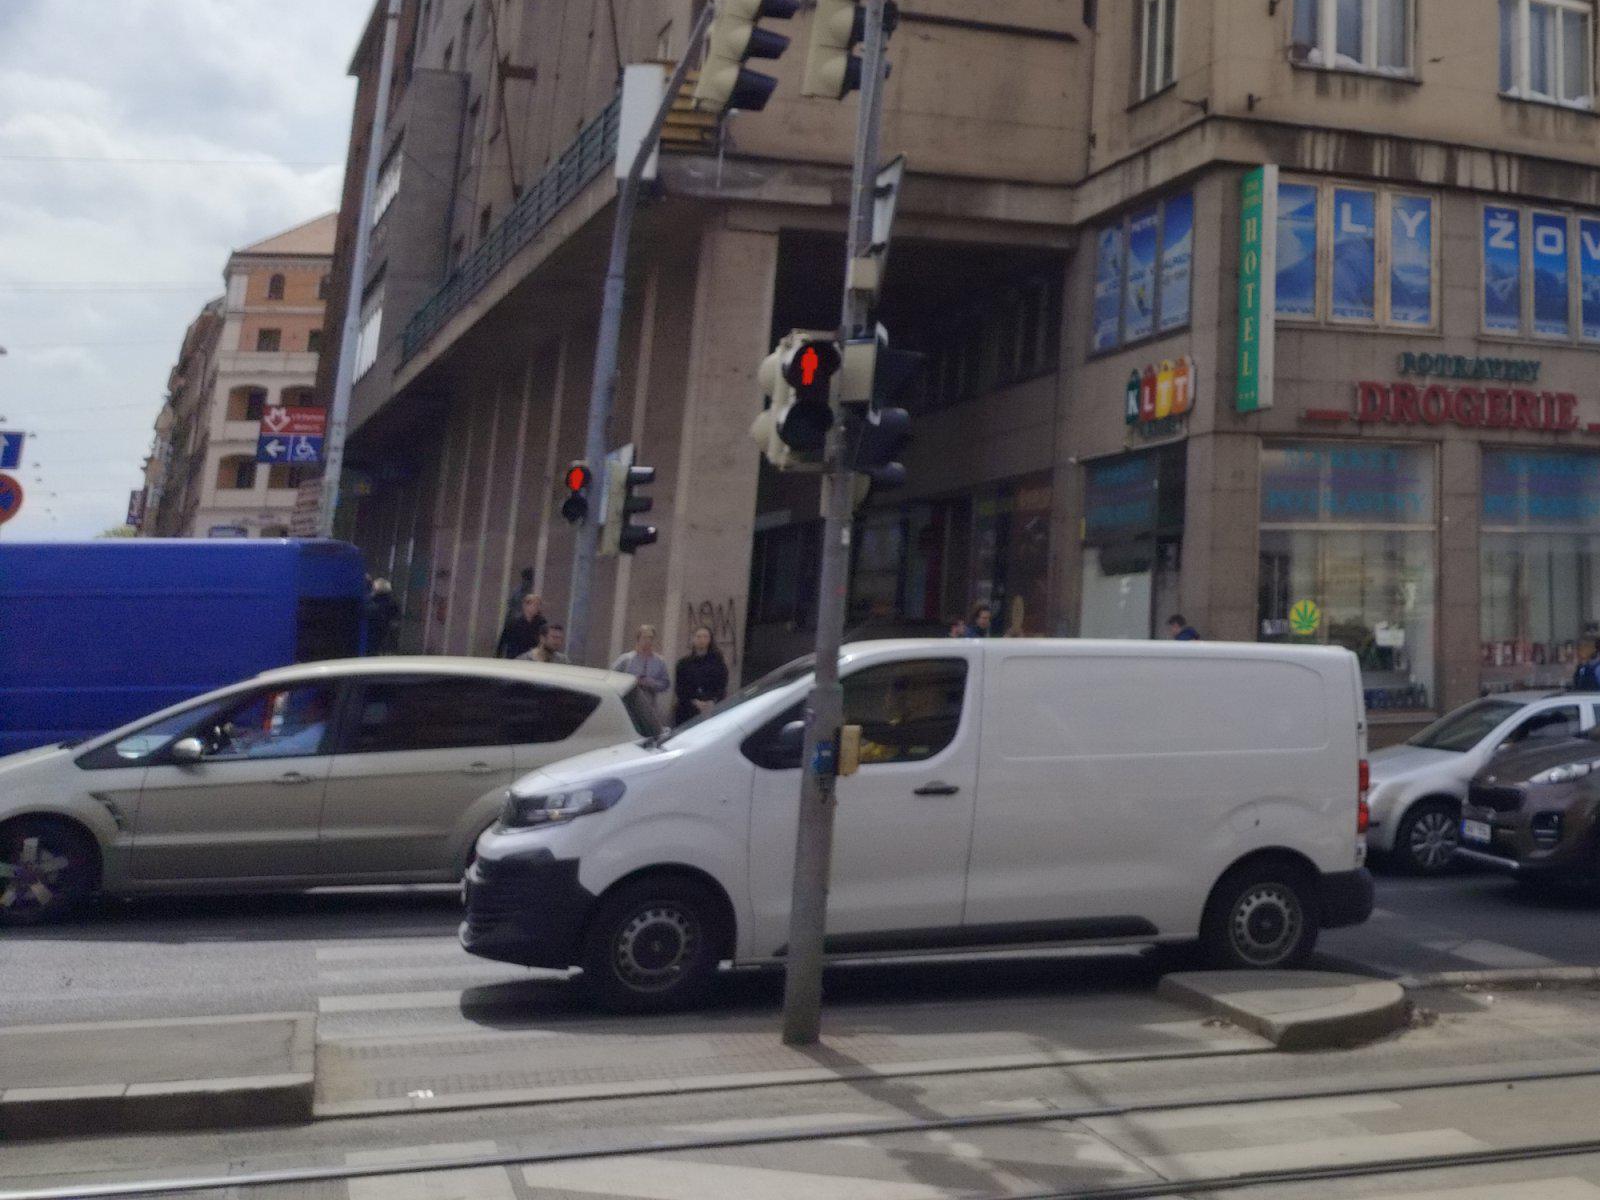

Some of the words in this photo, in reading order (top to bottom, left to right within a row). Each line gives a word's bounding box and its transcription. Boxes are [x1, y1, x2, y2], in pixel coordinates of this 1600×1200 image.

[1242, 217, 1258, 377] HOTEL
[1401, 351, 1541, 381] POTRAVINY
[1358, 381, 1579, 431] DROGERIE
